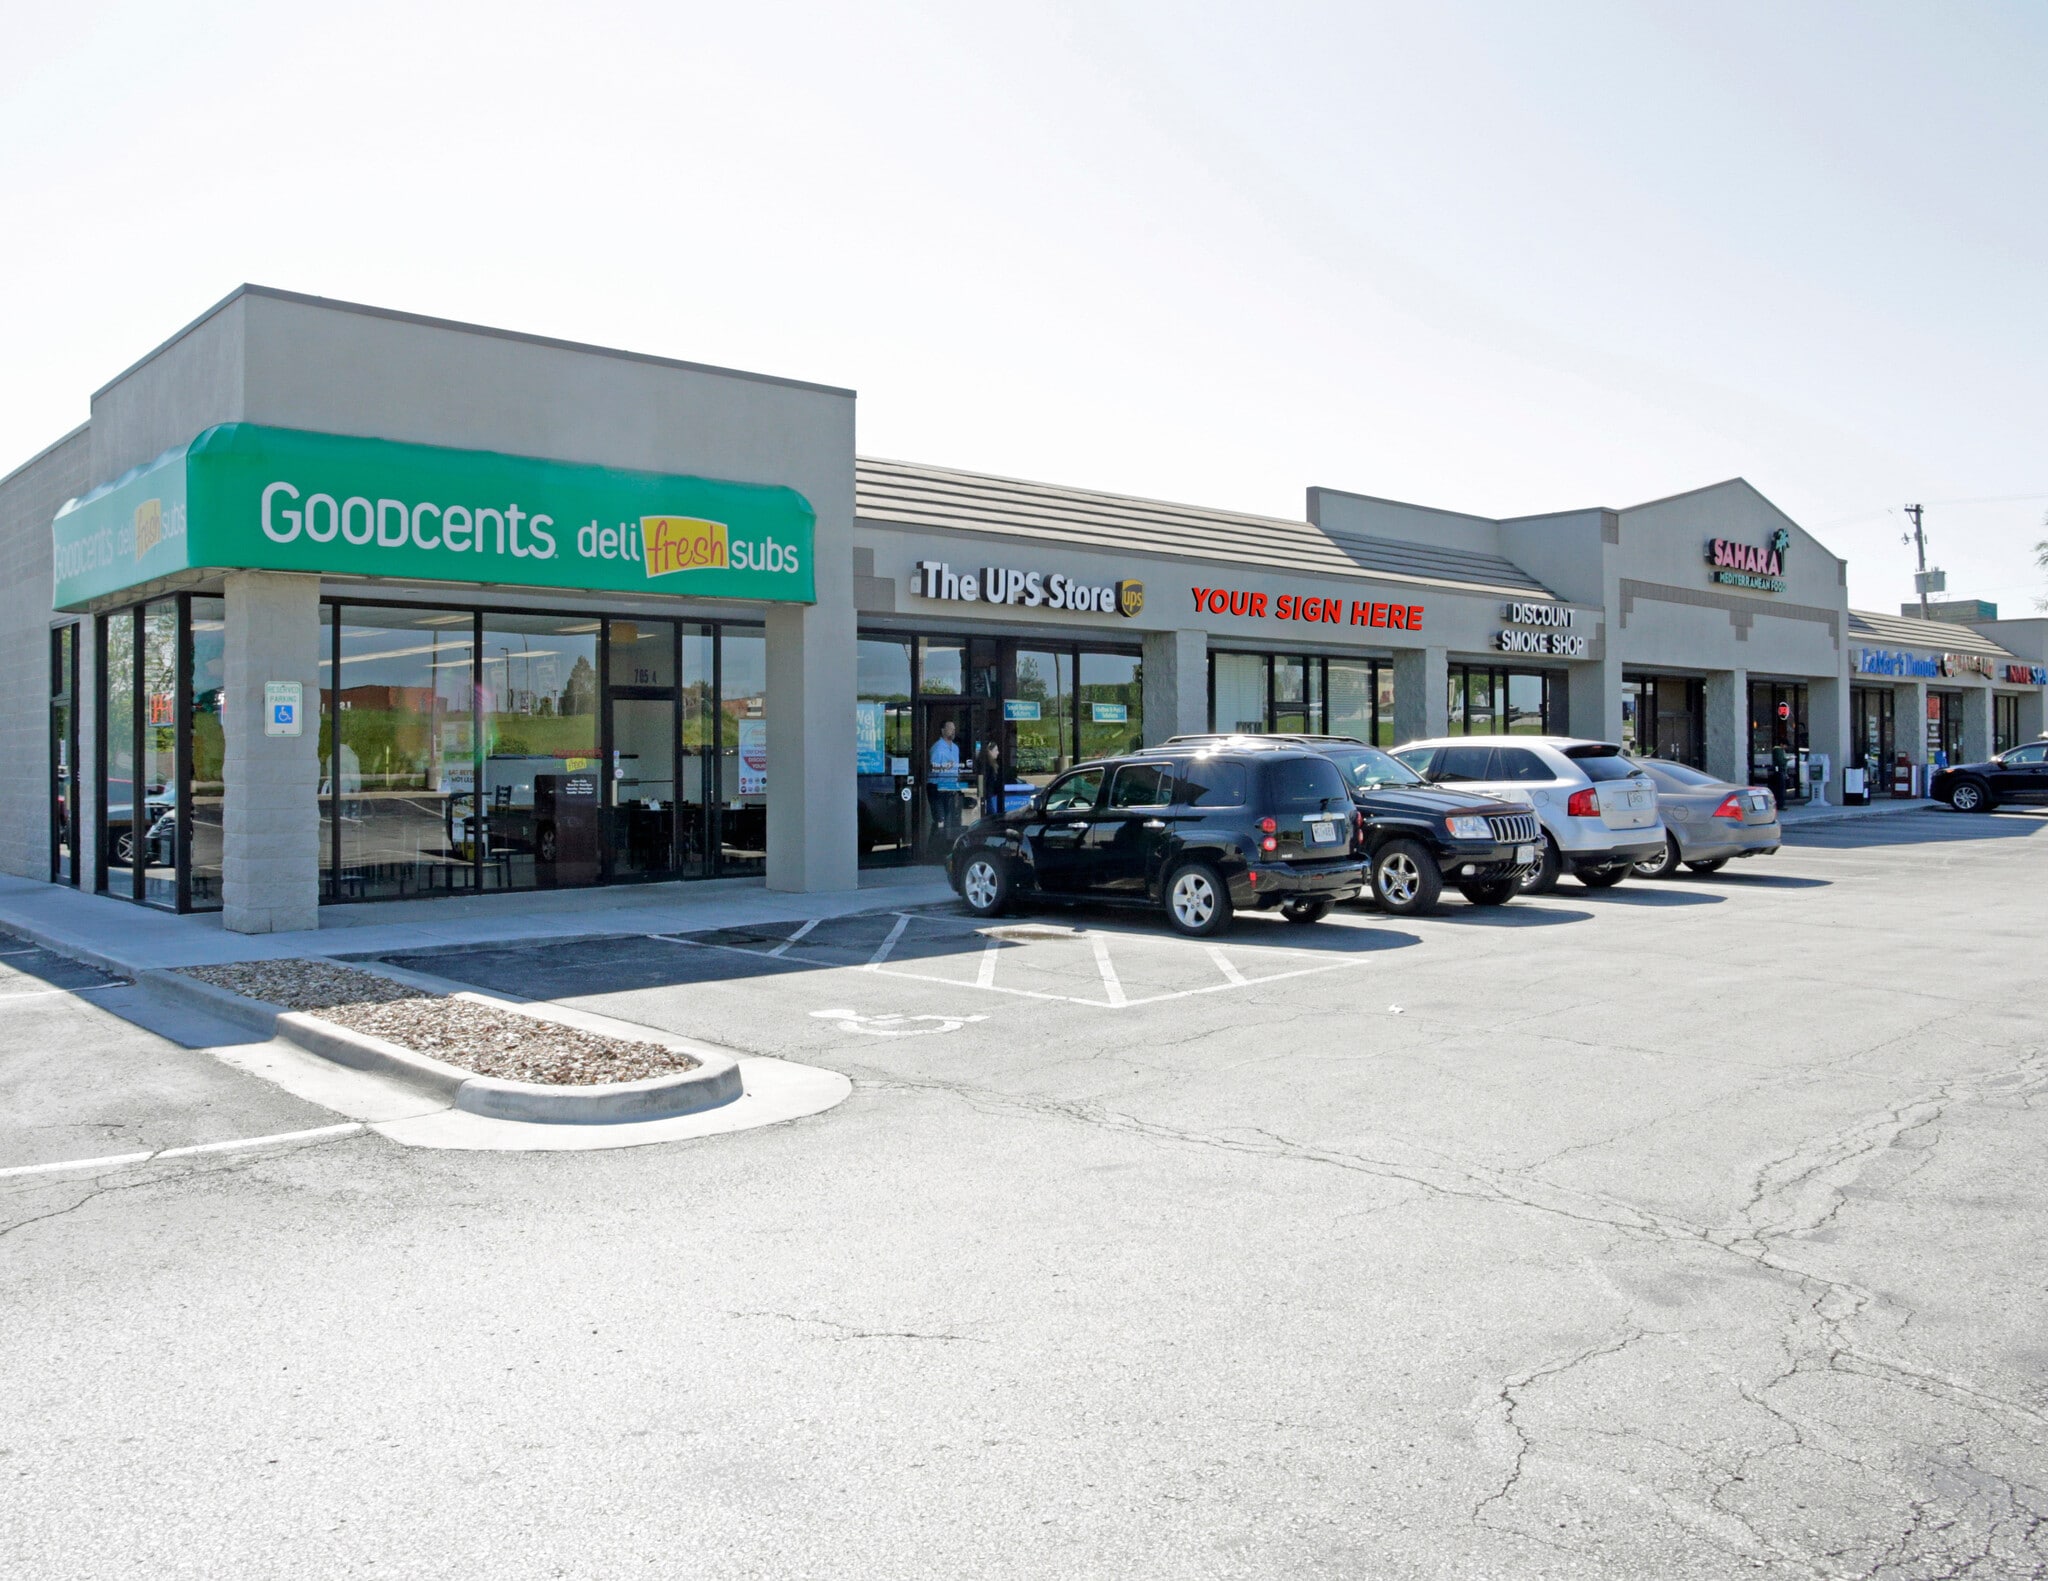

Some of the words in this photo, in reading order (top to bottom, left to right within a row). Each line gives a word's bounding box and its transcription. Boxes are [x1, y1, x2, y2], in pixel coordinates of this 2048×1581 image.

[161, 501, 185, 541] subs
[577, 519, 640, 561] deli
[647, 519, 724, 573] fresh
[731, 536, 799, 573] subs
[1714, 538, 1780, 577] SAHARA
[920, 560, 977, 600] The
[984, 567, 1042, 607] UPS
[1049, 574, 1115, 613] Store
[1123, 590, 1142, 613] ups
[1192, 587, 1268, 617] YOUR
[1275, 594, 1342, 624] SIGN
[1350, 600, 1424, 630] HERE
[1512, 603, 1575, 627] DISCOUNT
[1502, 630, 1548, 653] SMOKE
[1552, 635, 1584, 655] SHOP
[269, 695, 297, 703] PARKING
